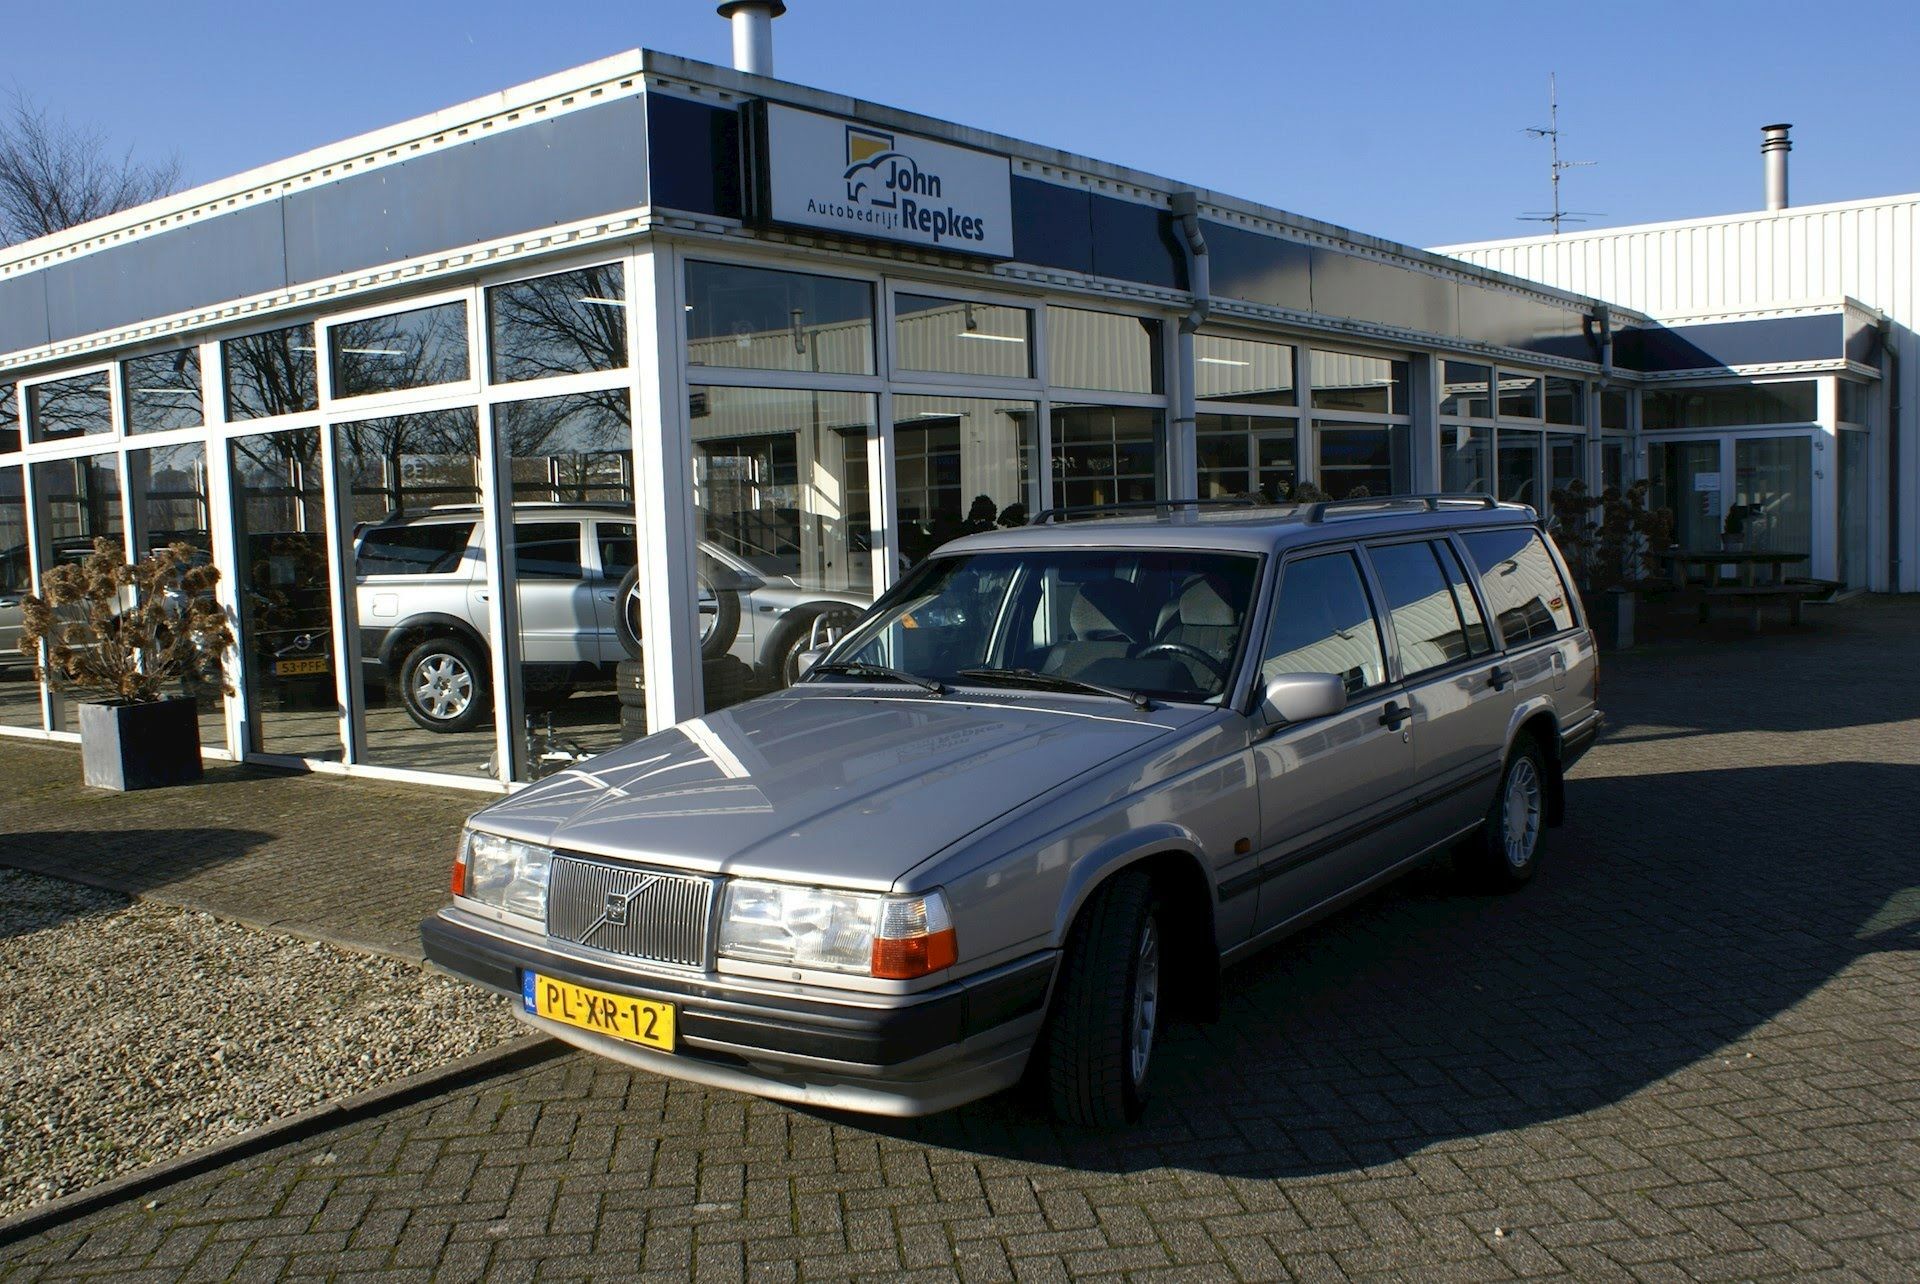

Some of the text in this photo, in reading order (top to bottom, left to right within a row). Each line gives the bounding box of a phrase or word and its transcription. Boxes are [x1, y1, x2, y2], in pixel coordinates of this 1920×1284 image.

[886, 160, 941, 198] John
[807, 198, 984, 242] Autobedrijf Repkes
[282, 660, 325, 673] 53-PFF-
[525, 996, 536, 1008] NL
